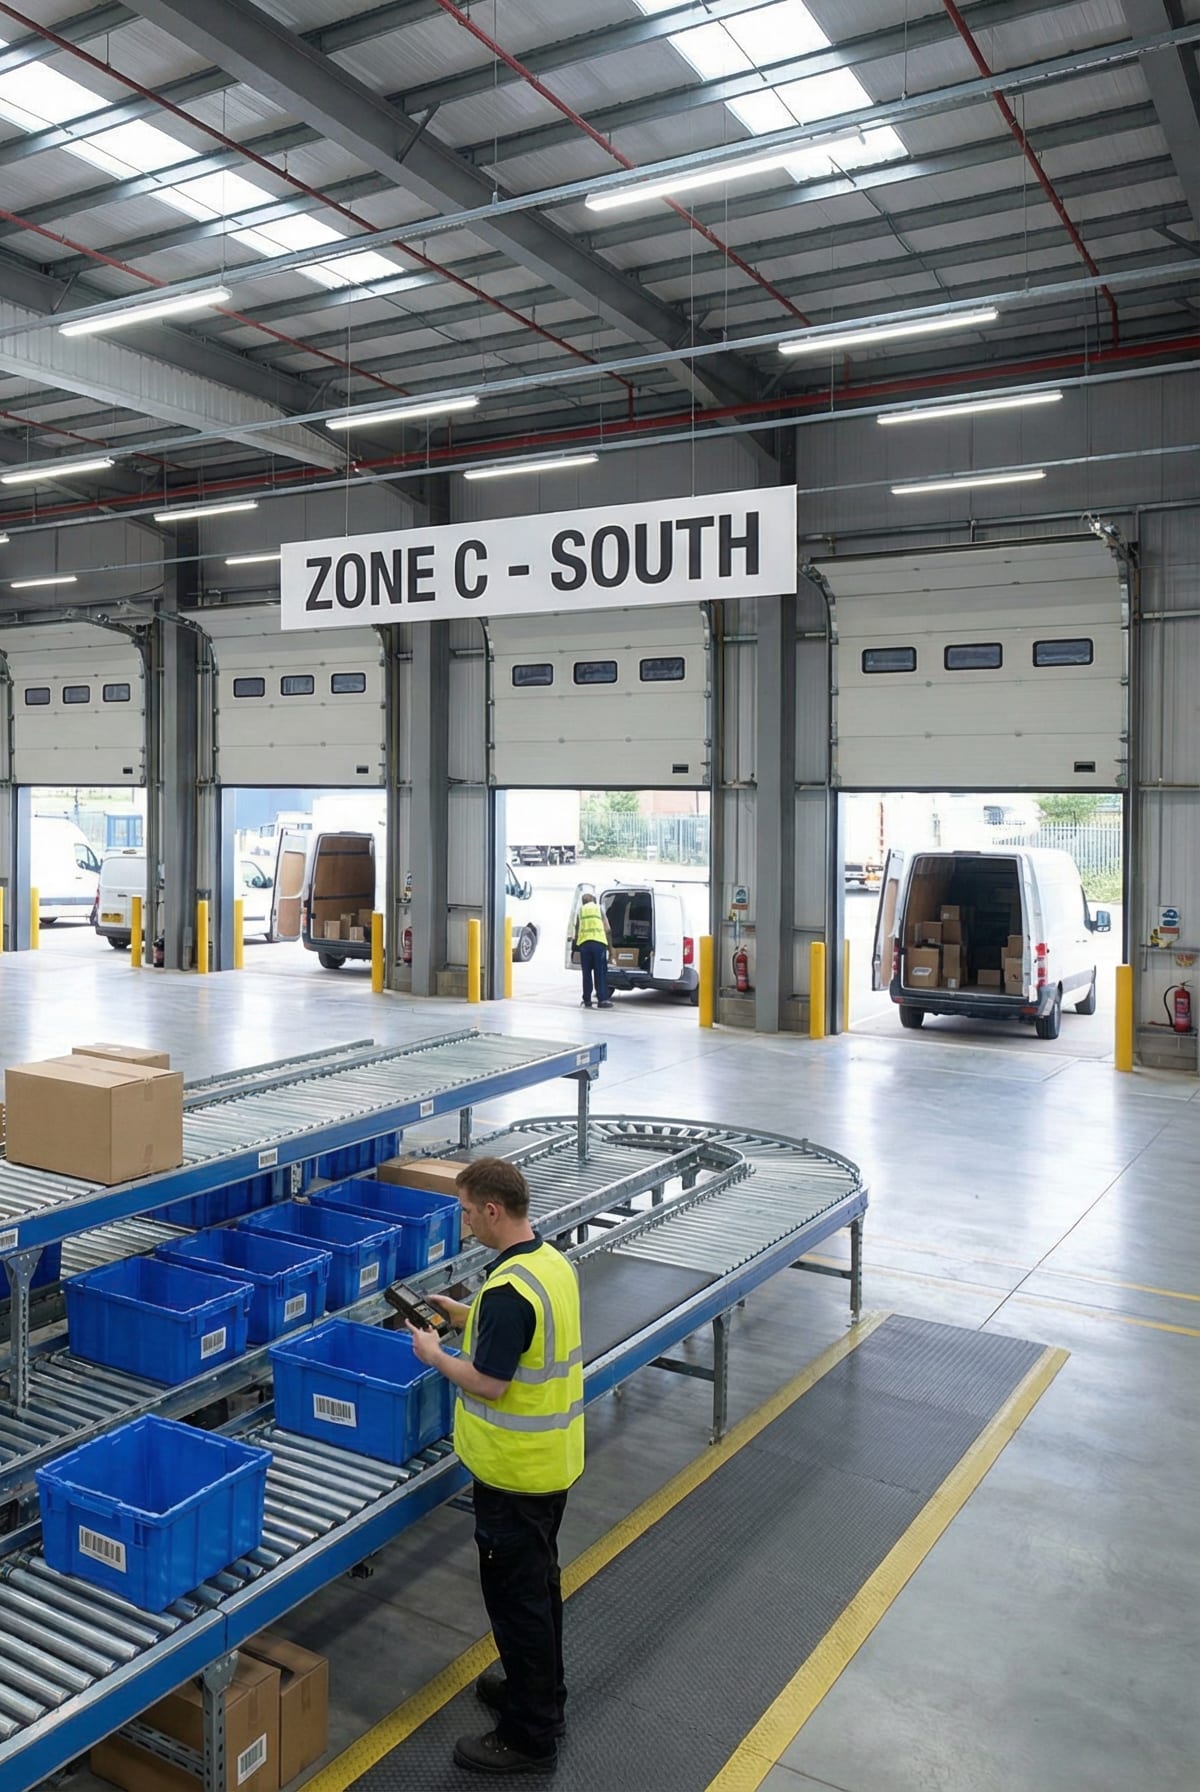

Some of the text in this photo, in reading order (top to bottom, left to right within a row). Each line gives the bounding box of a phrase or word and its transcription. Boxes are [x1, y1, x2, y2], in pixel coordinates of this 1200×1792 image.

[305, 511, 760, 612] ZONE C - SOUTH
